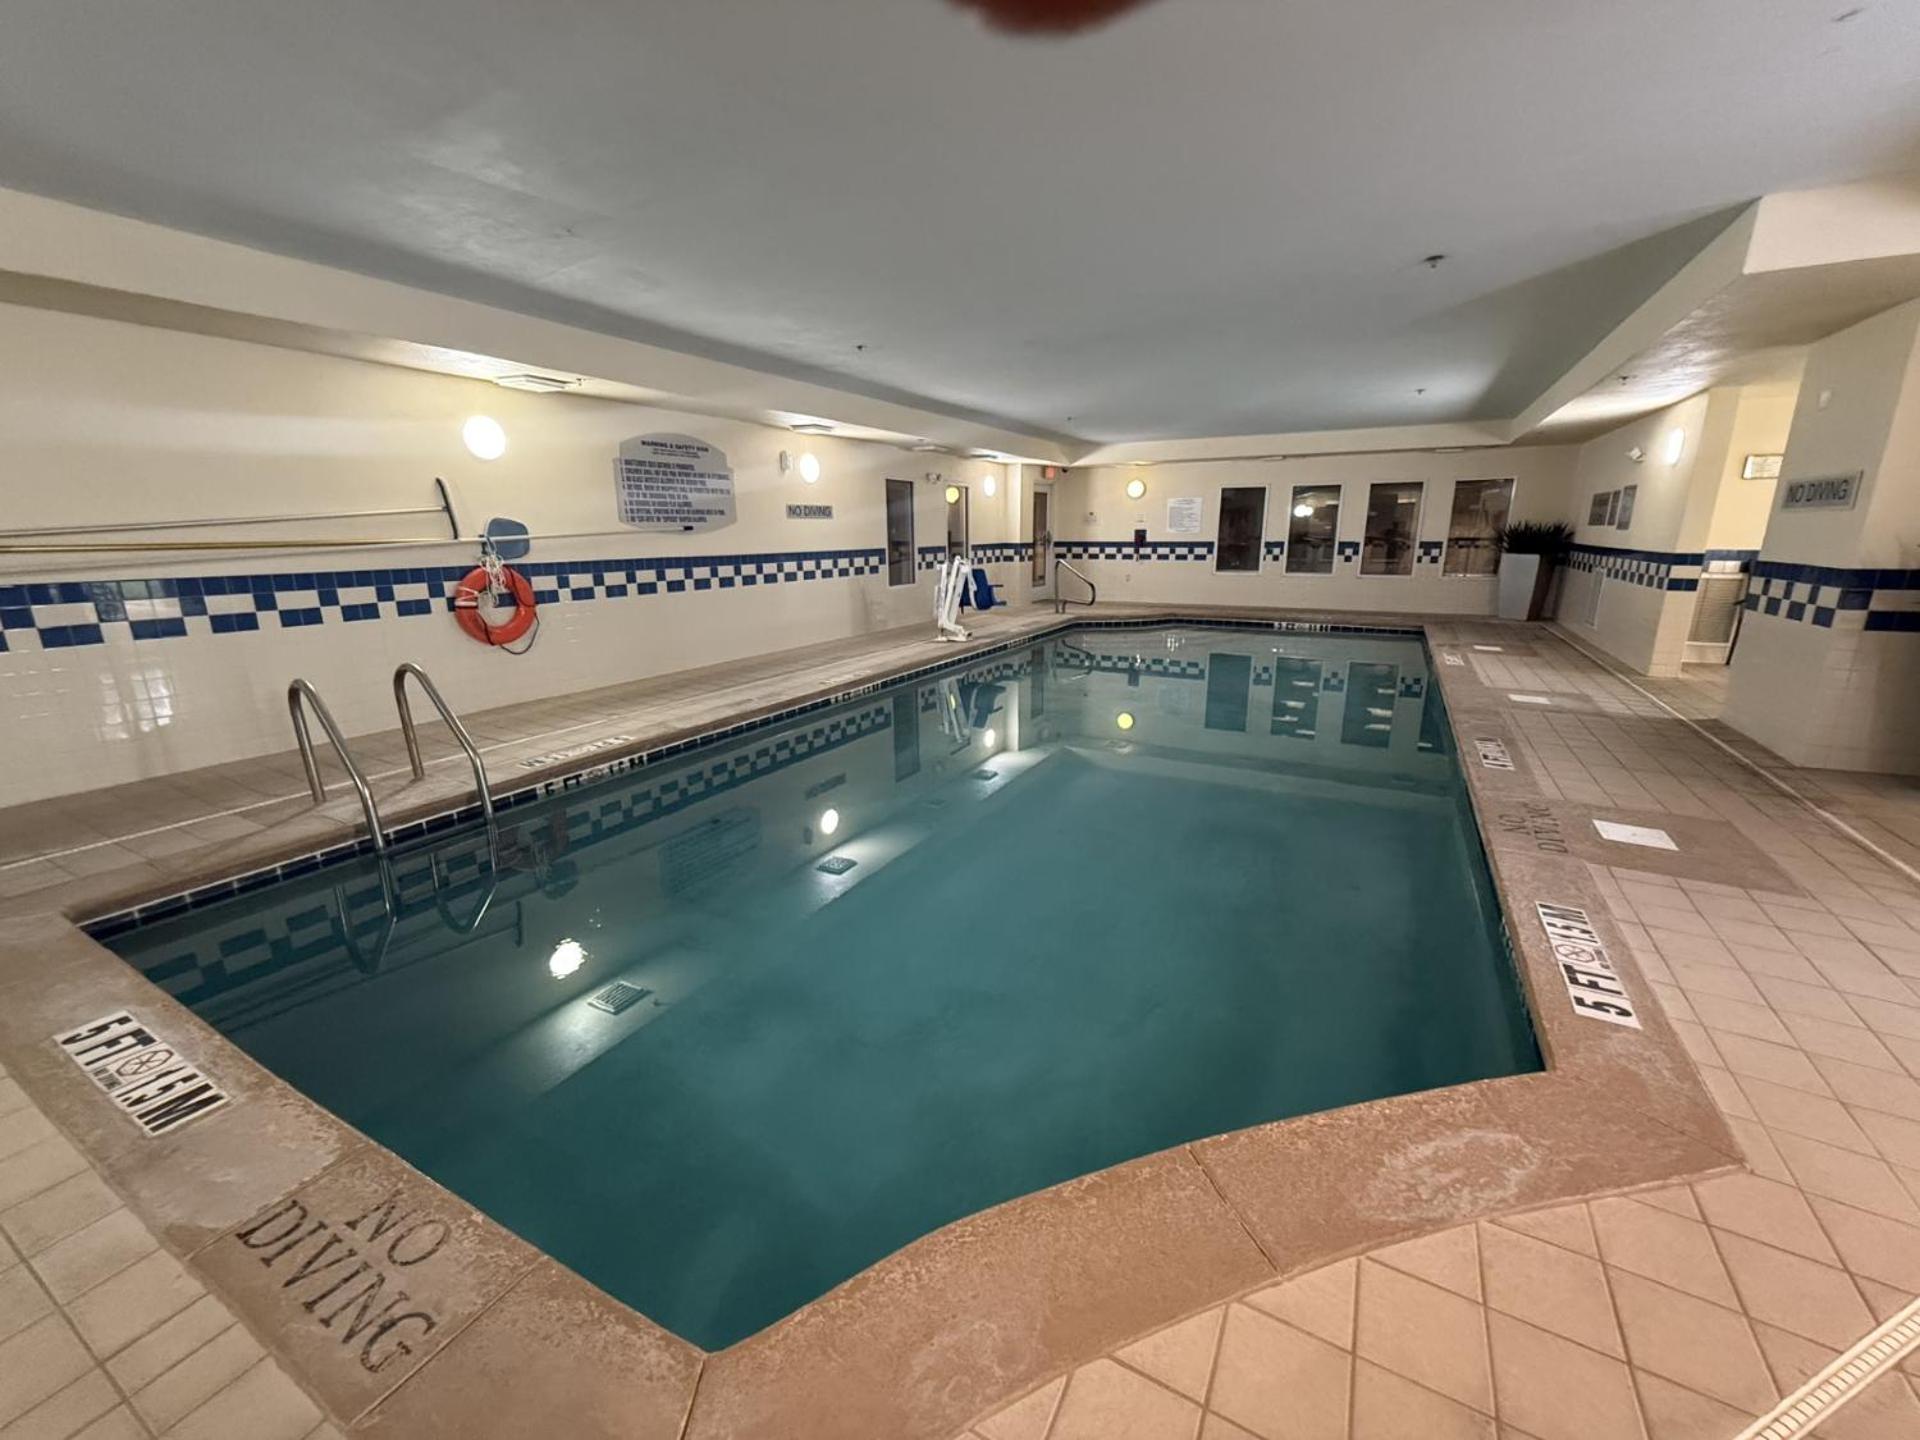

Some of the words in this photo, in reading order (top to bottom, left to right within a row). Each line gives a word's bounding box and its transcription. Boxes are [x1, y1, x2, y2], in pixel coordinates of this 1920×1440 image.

[1787, 484, 1803, 503] NO
[1806, 479, 1849, 502] DIVING
[787, 504, 802, 517] NO
[803, 504, 832, 517] DIVING
[1498, 813, 1532, 836] NO
[1562, 963, 1624, 996] FT
[1573, 995, 1633, 1018] 5
[61, 1015, 133, 1046] 5
[75, 1027, 157, 1067] FT
[346, 1186, 453, 1268] NO
[236, 1198, 437, 1374] DIVING
